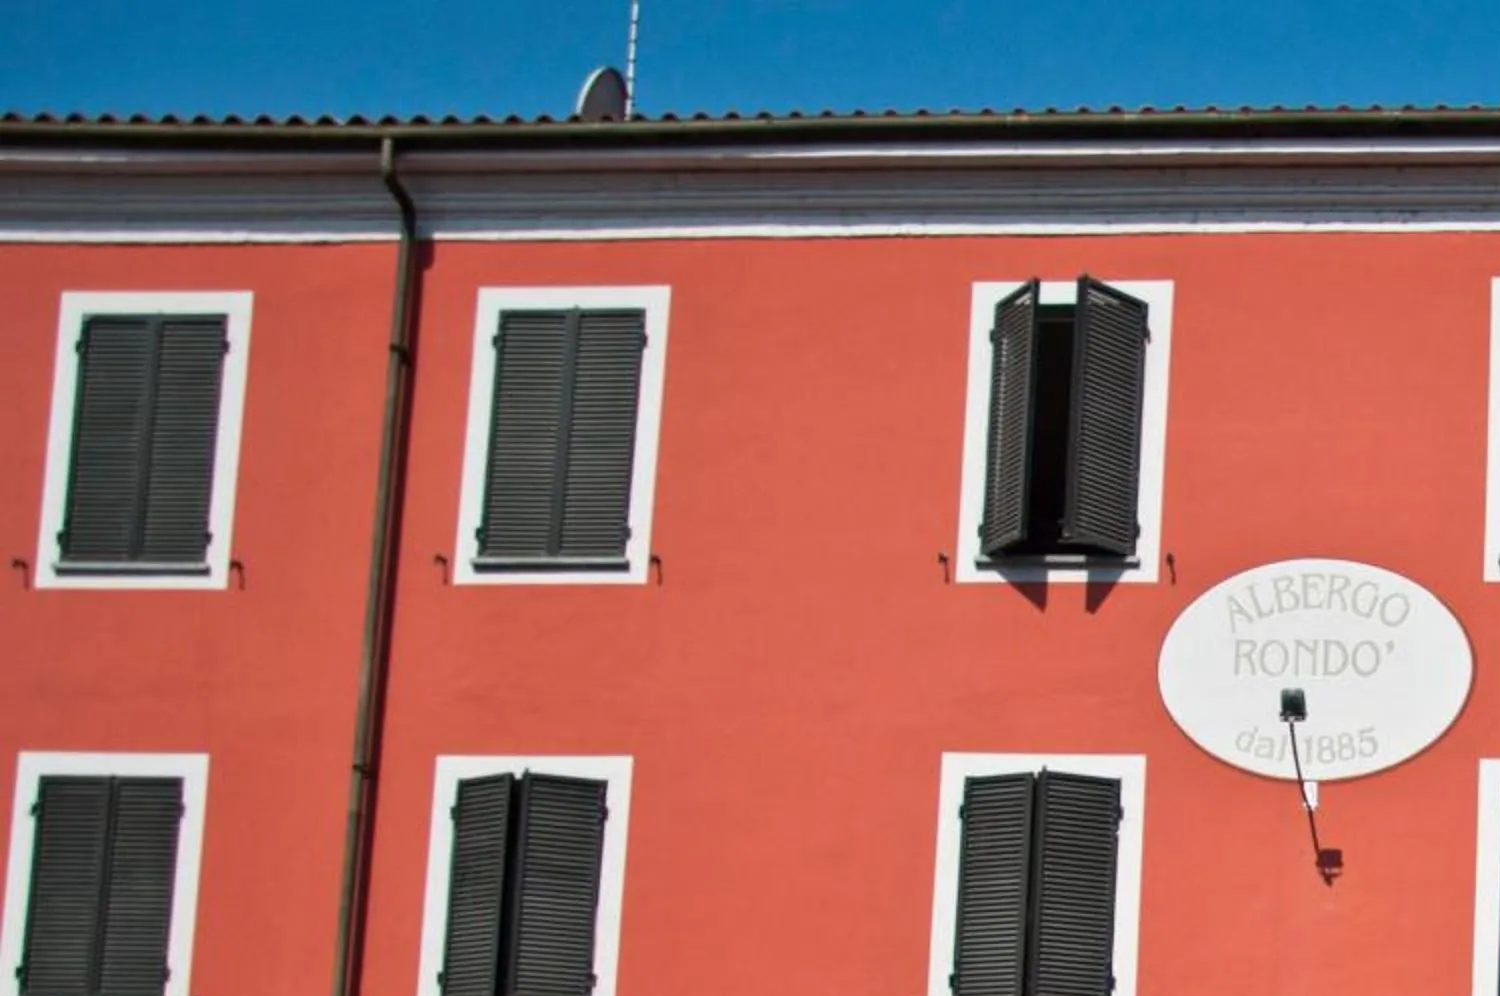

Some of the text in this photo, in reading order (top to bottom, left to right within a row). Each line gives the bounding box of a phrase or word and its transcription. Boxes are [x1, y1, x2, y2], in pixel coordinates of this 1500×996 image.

[1226, 572, 1411, 633] ALBERGO
[1233, 639, 1395, 677] RONDO'
[1235, 725, 1380, 765] dal 1885
